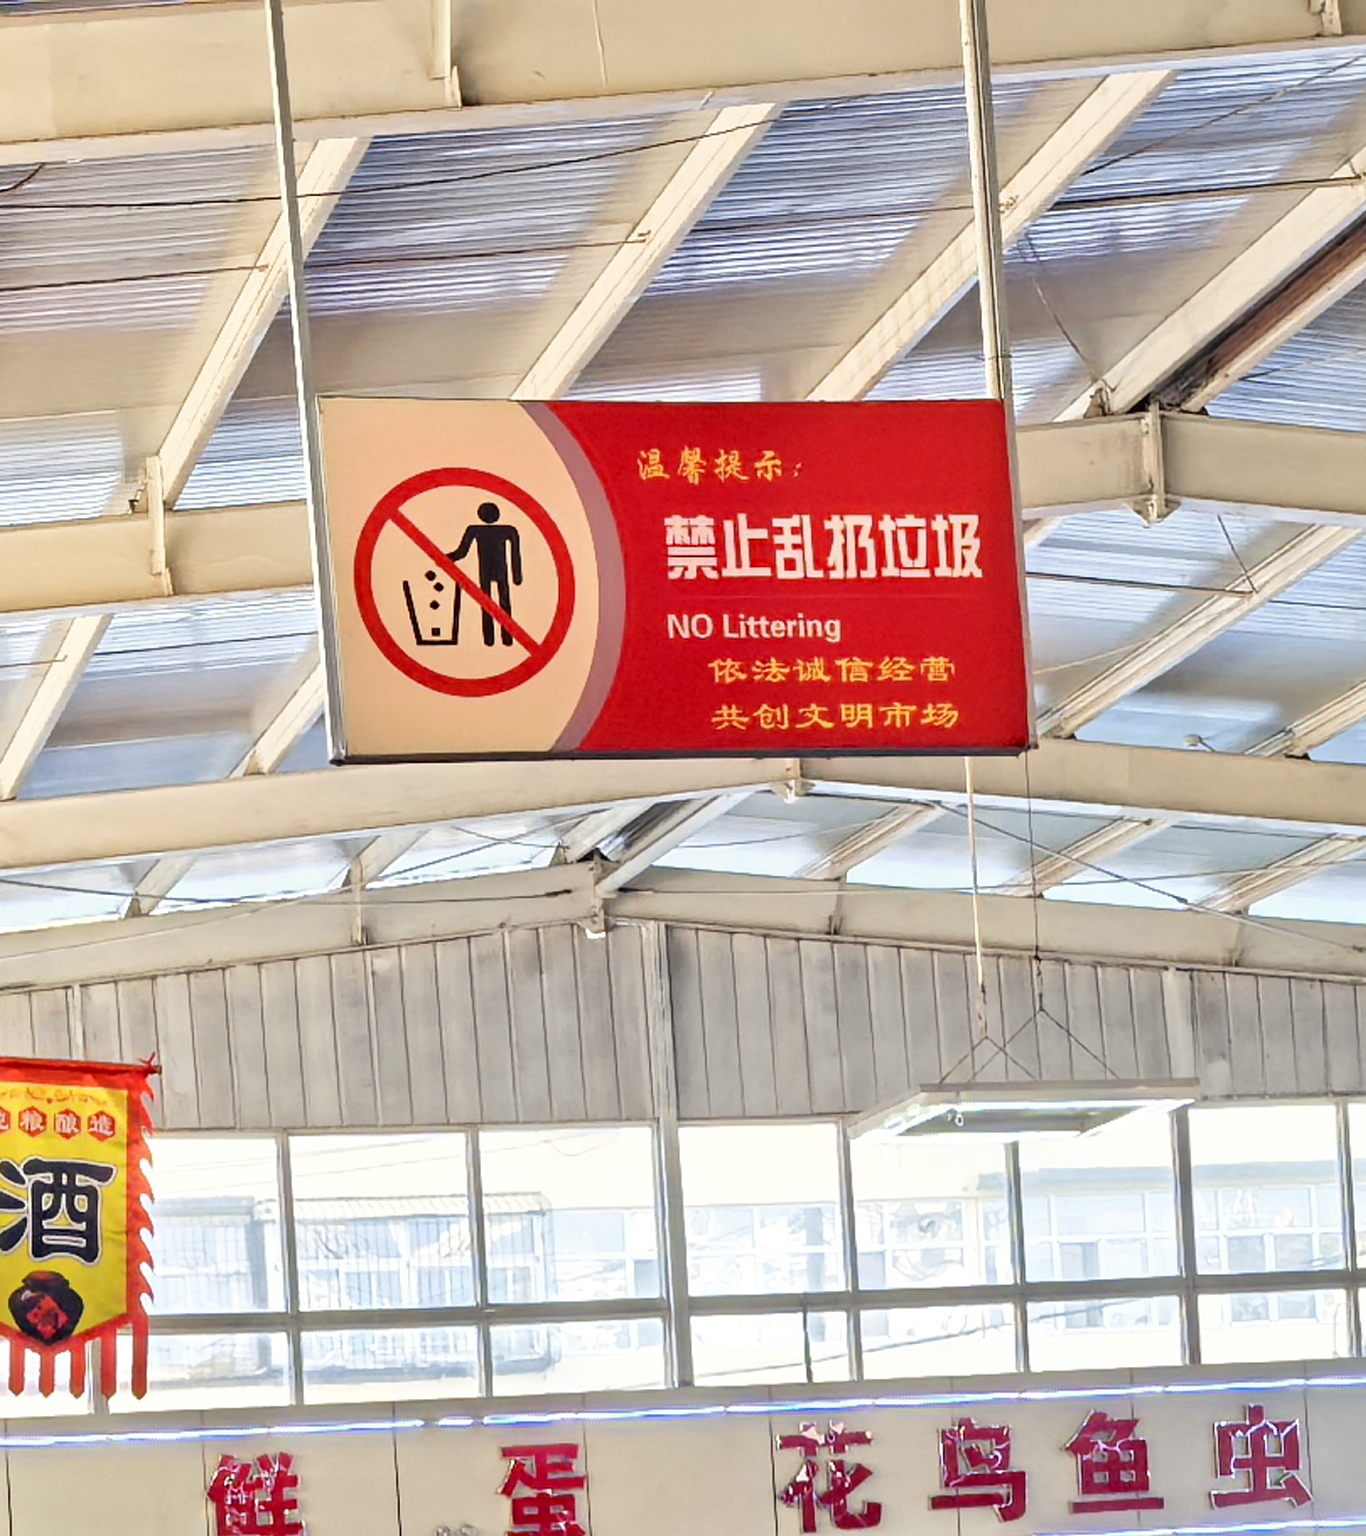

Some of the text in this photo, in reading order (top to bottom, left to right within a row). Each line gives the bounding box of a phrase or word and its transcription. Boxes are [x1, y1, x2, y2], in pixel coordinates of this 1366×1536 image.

[664, 513, 983, 580] 禁止乱扔垃圾
[667, 613, 842, 643] NO Littering
[707, 656, 956, 684] 依法诚信经营
[710, 702, 959, 731] 共创文明市场
[775, 1402, 1315, 1534] 花鸟鱼虫
